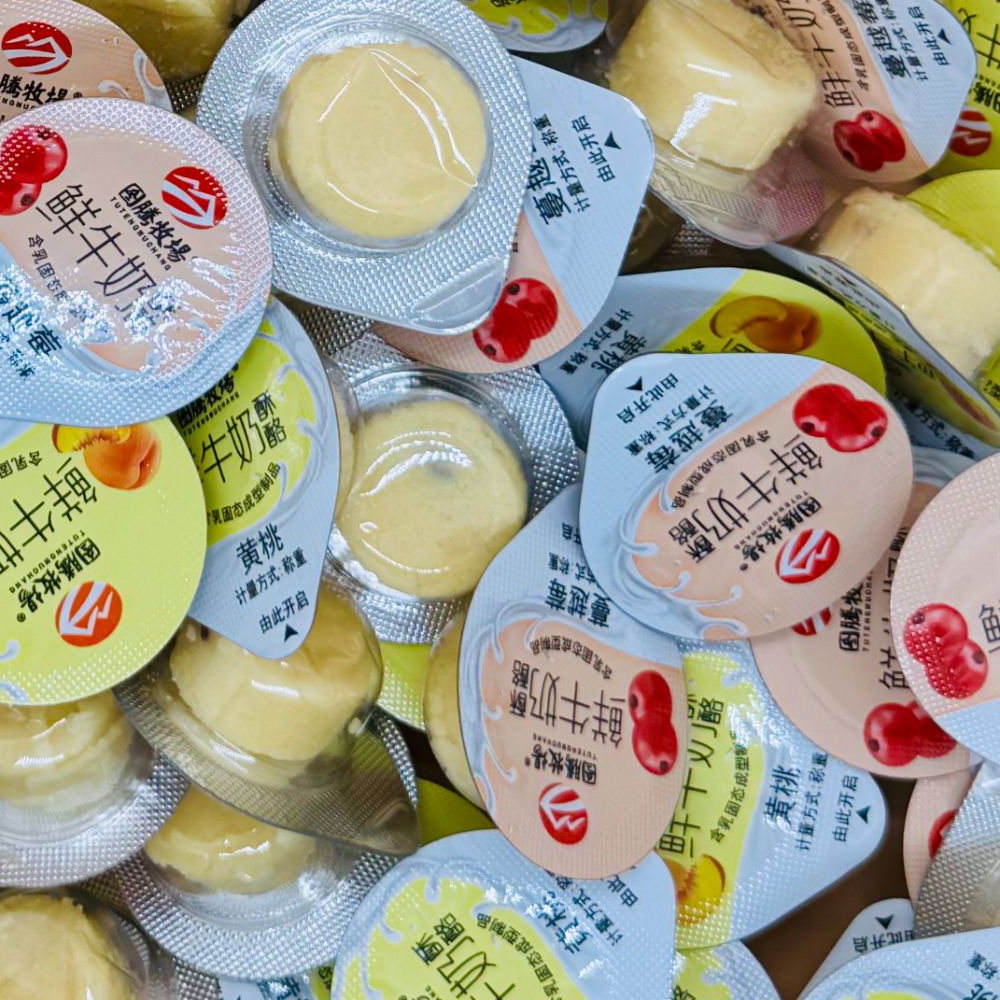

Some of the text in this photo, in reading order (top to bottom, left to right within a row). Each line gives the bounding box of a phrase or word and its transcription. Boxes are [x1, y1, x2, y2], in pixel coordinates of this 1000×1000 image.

[906, 5, 948, 65] 由此开启
[570, 113, 615, 183] 由此开启
[615, 372, 679, 425] 由此开启
[640, 399, 735, 474] 蔓越莓
[233, 520, 286, 575] 黄桃
[258, 589, 309, 633] 由此开启
[544, 574, 610, 631] 蔓越莓
[759, 762, 805, 828] 黄桃
[832, 773, 860, 842] 由此开启
